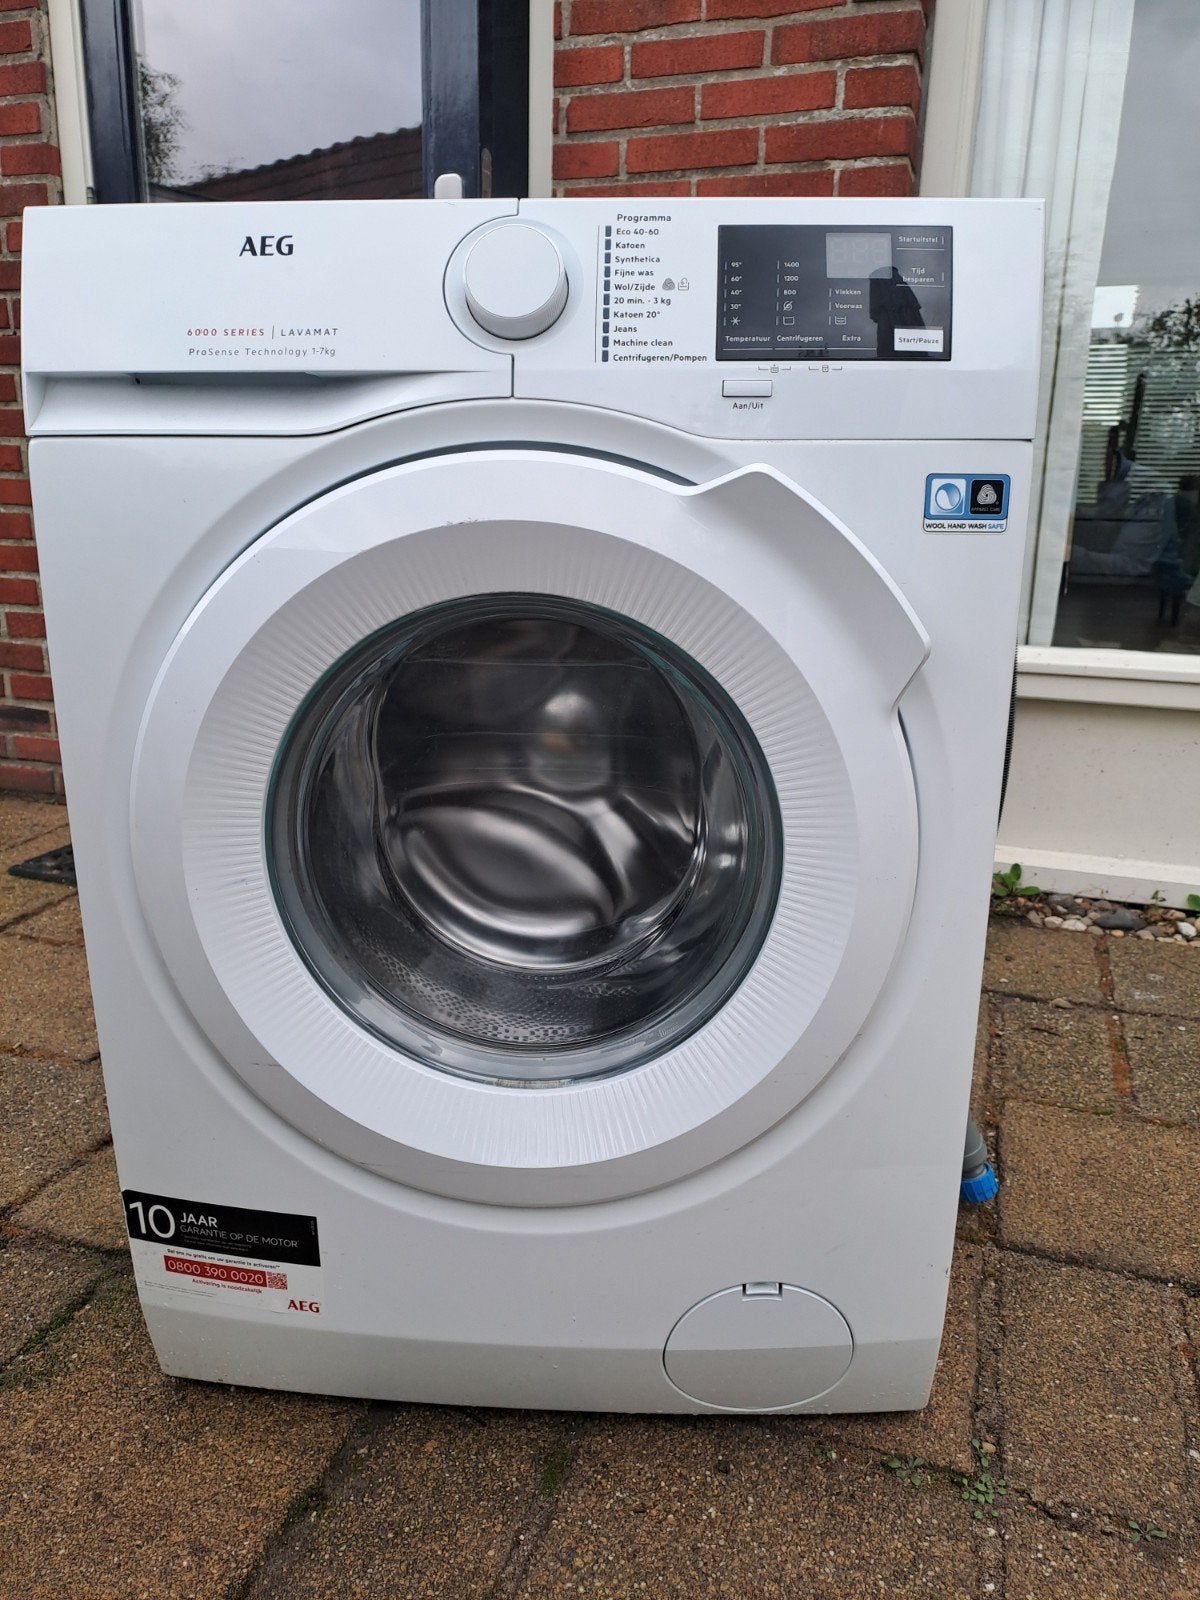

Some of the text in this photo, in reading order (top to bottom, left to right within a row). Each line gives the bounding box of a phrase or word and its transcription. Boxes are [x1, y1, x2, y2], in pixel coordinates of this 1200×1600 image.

[616, 213, 672, 224] Programma
[616, 227, 660, 236] Eco 40-60
[898, 235, 938, 243] Startuitstel
[239, 235, 294, 257] AEG
[615, 241, 646, 249] Katoen
[614, 255, 661, 264] Synthetica
[614, 268, 636, 278] Fijne
[911, 267, 926, 275] Tijd
[902, 275, 935, 284] besparen
[614, 282, 656, 292] Wol/Zijde
[834, 288, 862, 296] Vlekken
[613, 296, 625, 305] 20
[627, 296, 645, 305] min.
[653, 296, 659, 305] 3
[660, 296, 672, 306] kg
[613, 310, 661, 319] Katoen 20°
[187, 328, 338, 337] 6000 SERIES LAVAMAT
[613, 325, 638, 333] Jeans
[613, 338, 674, 347] Machine clean
[725, 334, 771, 343] Temperatuur
[776, 334, 824, 343] Centrifugeren
[842, 334, 862, 342] Extra
[898, 336, 939, 345] Start/Pauze
[188, 346, 336, 358] ProSense Technology 1-7kg
[612, 353, 708, 363] Centrifugeren/Pompen
[732, 402, 764, 410] Aan/Uit
[129, 1201, 176, 1239] 10
[180, 1212, 218, 1228] JAAR
[180, 1225, 228, 1240] GARANTIE
[229, 1232, 244, 1241] OP
[246, 1234, 260, 1244] DE
[167, 1259, 264, 1284] 0800 390 0020
[287, 1299, 320, 1314] AEG
